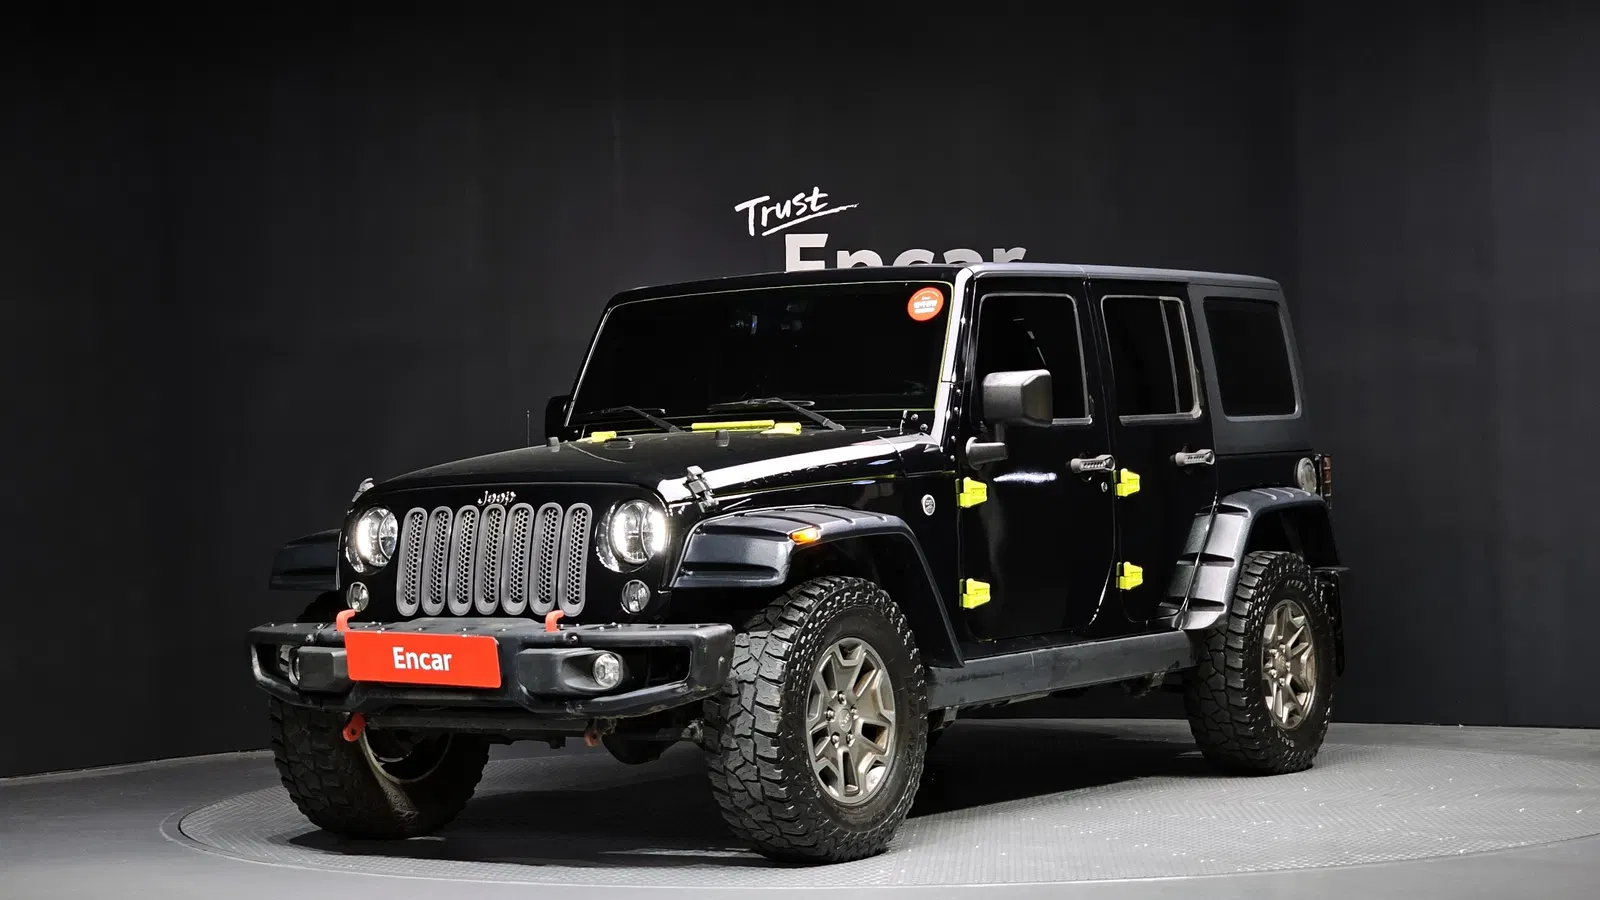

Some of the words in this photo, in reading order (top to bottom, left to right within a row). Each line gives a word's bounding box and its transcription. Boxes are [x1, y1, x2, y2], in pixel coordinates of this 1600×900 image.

[734, 186, 830, 236] Trust
[477, 490, 517, 506] Jeep
[392, 646, 453, 672] Encar
